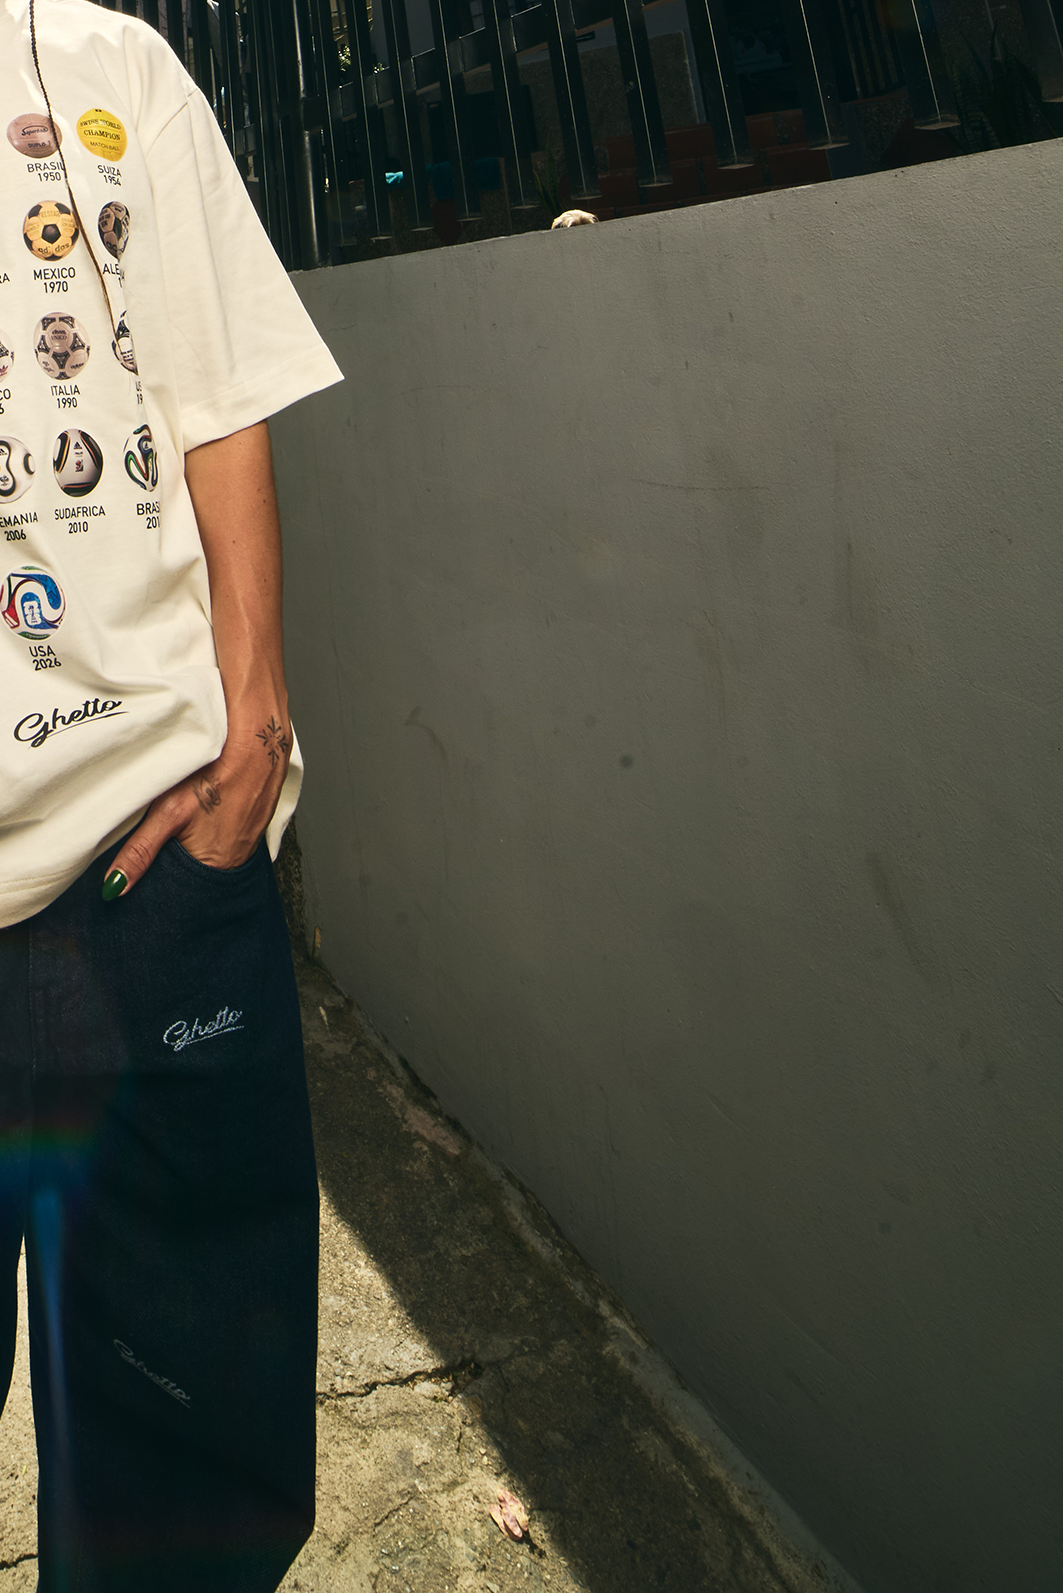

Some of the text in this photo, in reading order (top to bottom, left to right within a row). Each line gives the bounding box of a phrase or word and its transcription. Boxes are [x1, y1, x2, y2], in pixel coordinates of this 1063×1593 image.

[83, 129, 121, 140] CHAMPION
[26, 161, 65, 173] BRASIL
[97, 164, 122, 177] SUIZA
[37, 172, 62, 182] 1950
[103, 174, 122, 186] 1954
[33, 267, 76, 281] MEXICO
[43, 281, 68, 293] 1970
[50, 384, 81, 396] ITALIA
[57, 397, 78, 409] 1990
[54, 505, 106, 521] SUDAFRICA
[68, 521, 89, 534] 2010
[4, 529, 27, 542] 2006
[29, 645, 56, 658] USA
[32, 657, 62, 672] 2026
[13, 697, 127, 748] Ghetto
[163, 1006, 244, 1052] Ghetto
